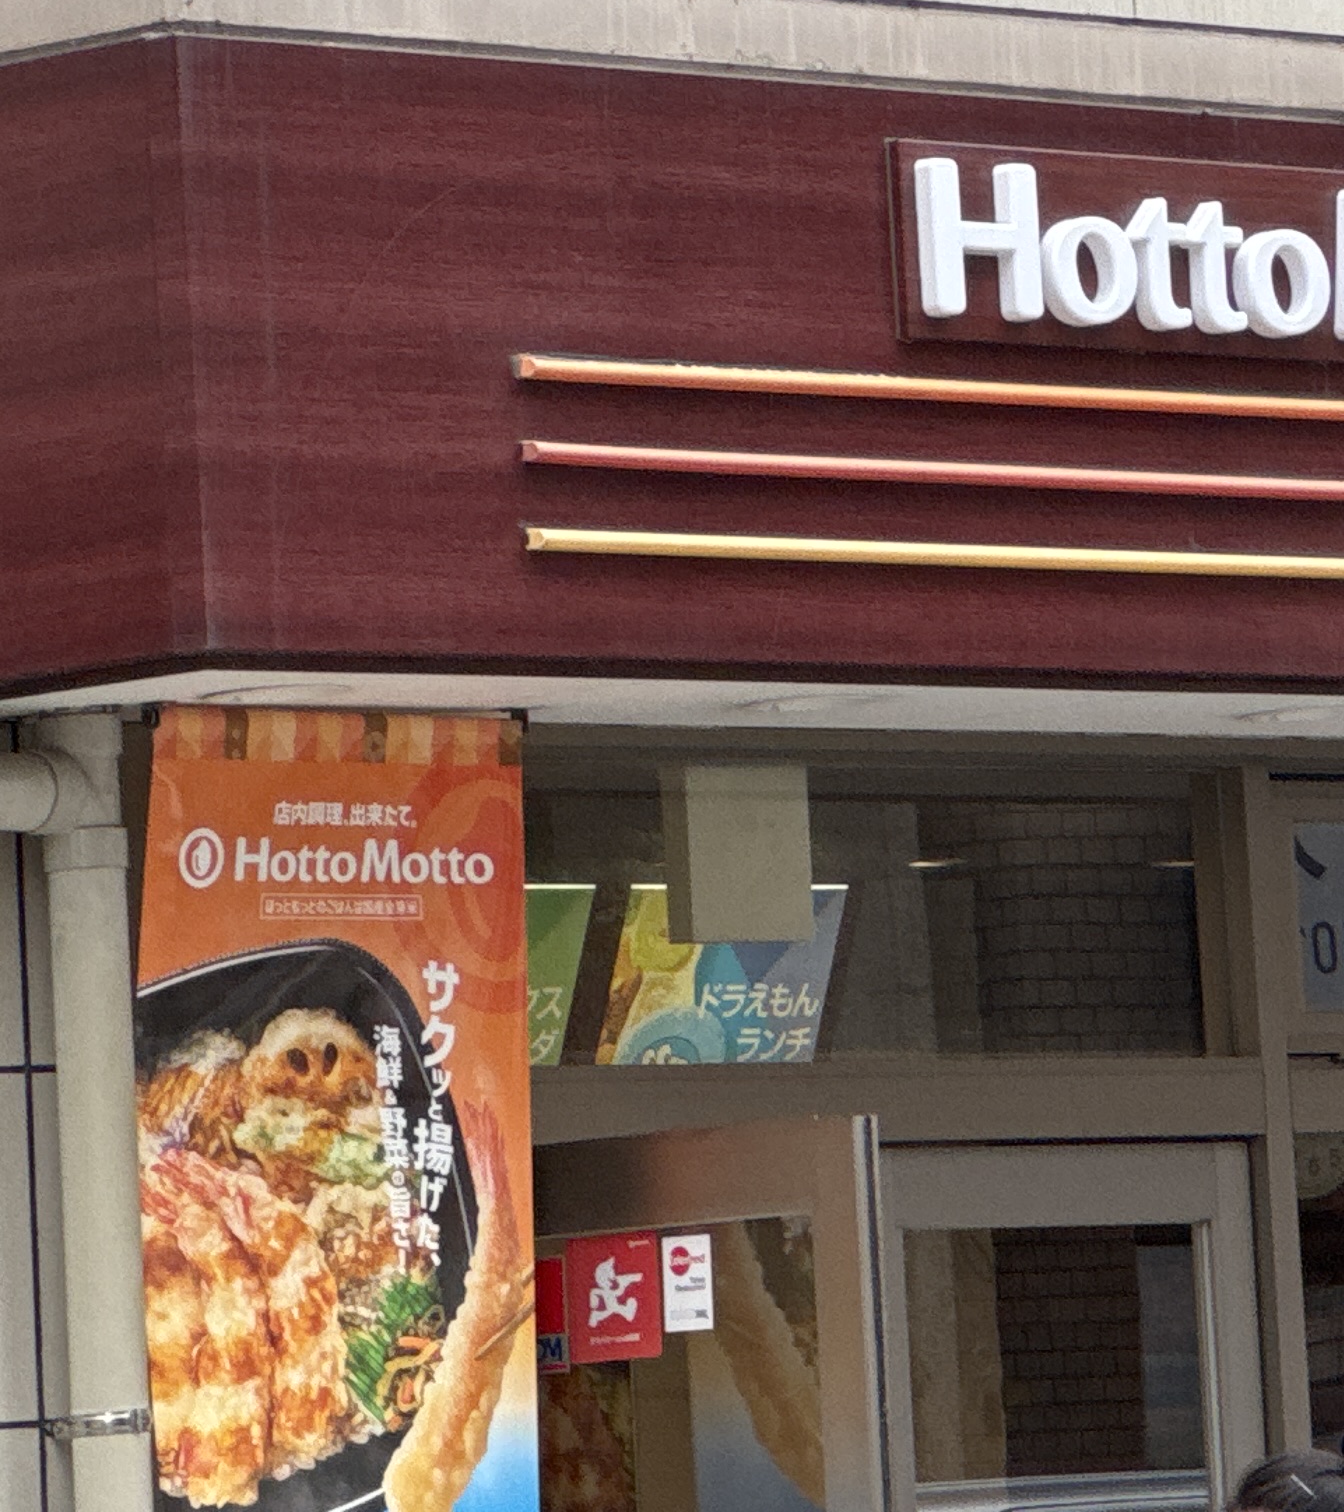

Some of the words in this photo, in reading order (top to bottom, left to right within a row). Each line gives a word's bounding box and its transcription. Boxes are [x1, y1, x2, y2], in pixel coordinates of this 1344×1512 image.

[698, 982, 820, 1019] ドラえもん
[735, 1025, 813, 1062] ランチ
